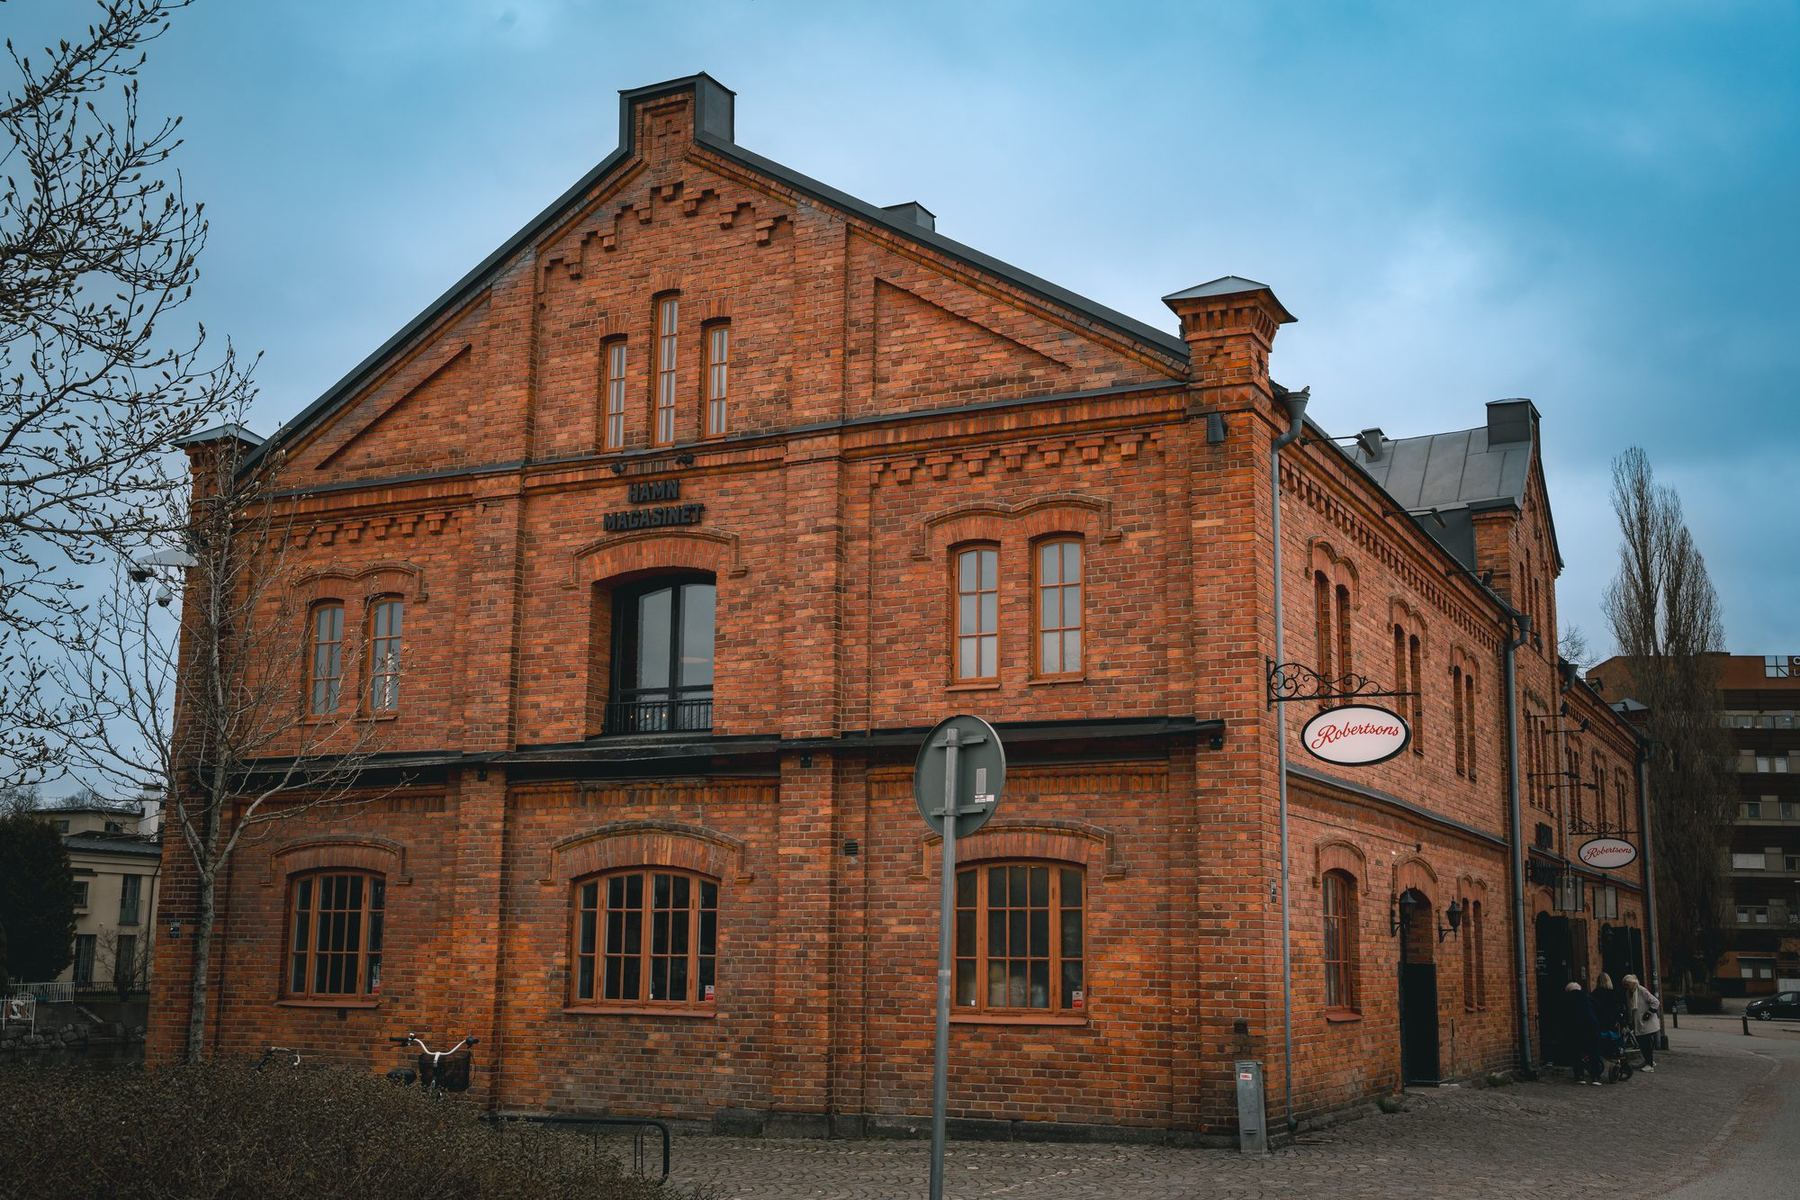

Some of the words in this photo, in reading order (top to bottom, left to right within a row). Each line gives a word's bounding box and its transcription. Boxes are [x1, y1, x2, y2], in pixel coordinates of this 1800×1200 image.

[628, 480, 680, 503] HAMN
[603, 504, 705, 531] MAGASINET
[1311, 722, 1399, 749] Robertsons
[1584, 846, 1632, 861] Robertsons
